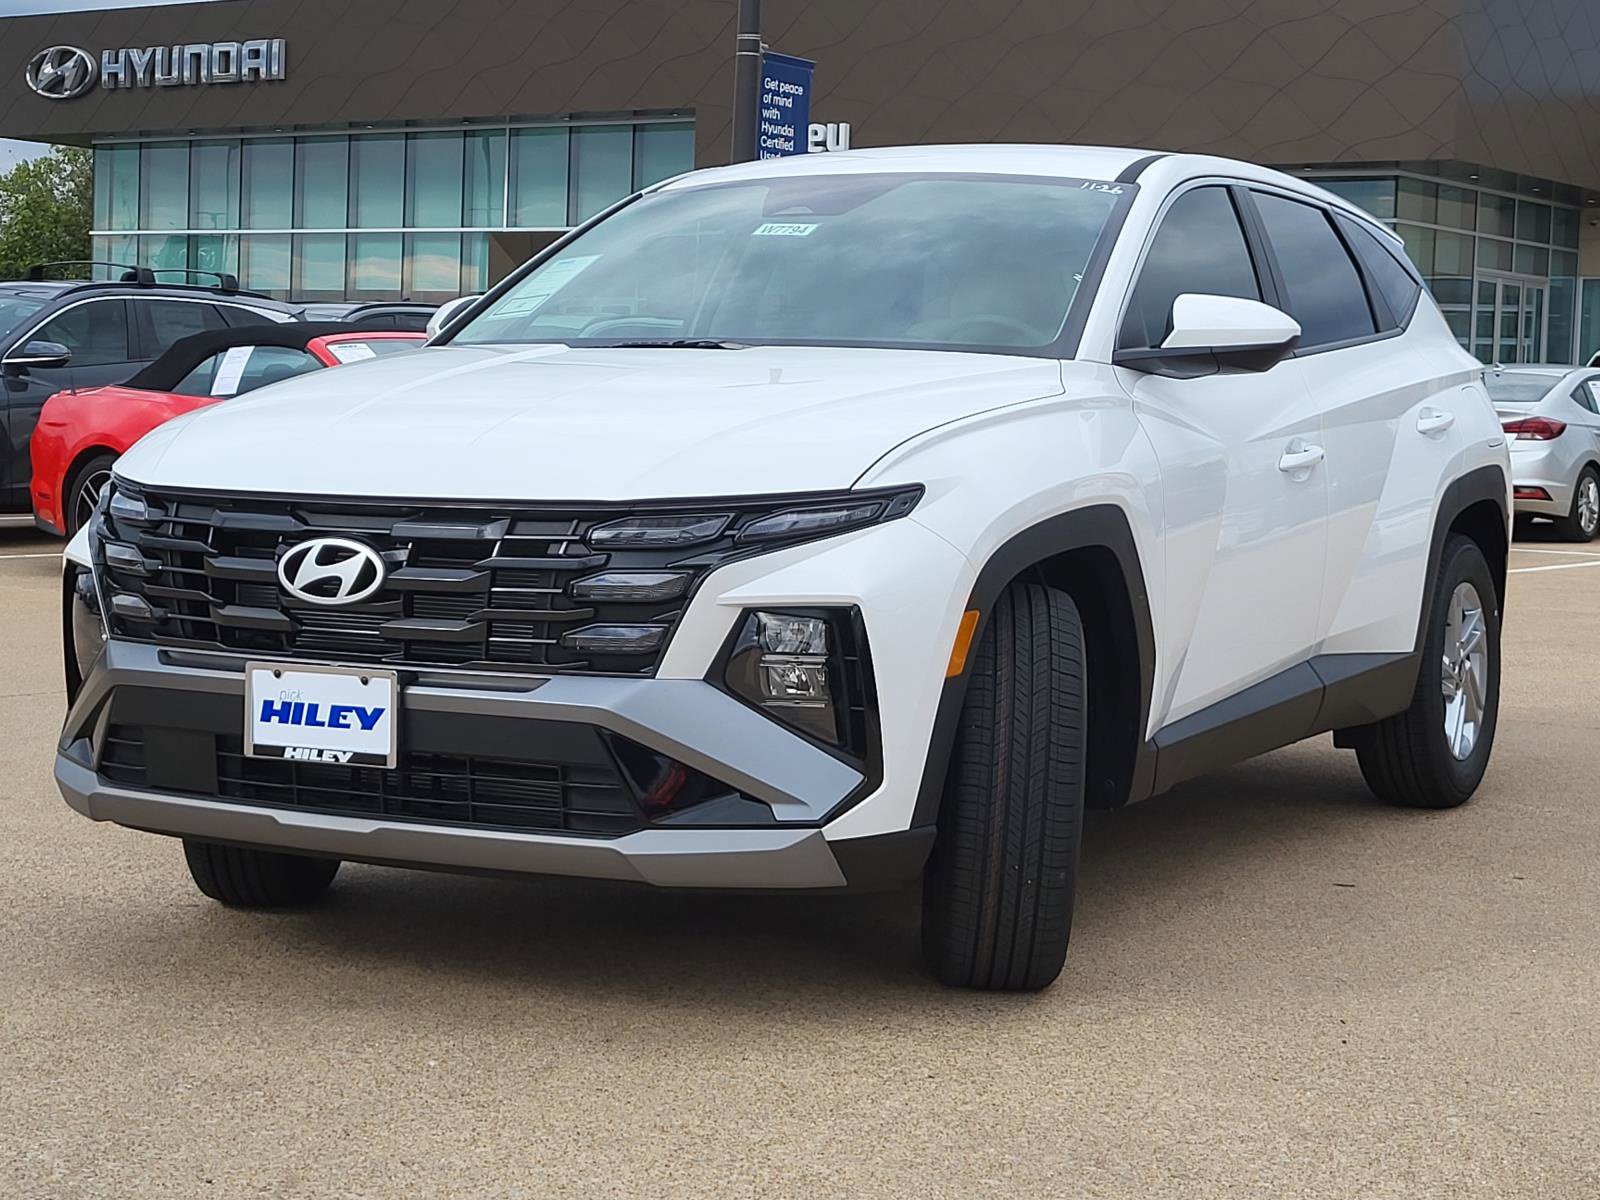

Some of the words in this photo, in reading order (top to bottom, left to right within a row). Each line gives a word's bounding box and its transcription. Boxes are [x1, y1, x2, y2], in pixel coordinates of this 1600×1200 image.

[102, 39, 286, 88] HYUNDAI
[764, 77, 779, 92] Get
[779, 83, 804, 95] peace
[763, 93, 772, 104] of
[772, 94, 793, 108] mind
[762, 107, 781, 120] with
[761, 121, 795, 137] Hyundai
[760, 136, 794, 151] Certified
[260, 699, 386, 731] HILEY
[283, 747, 354, 763] HILEY
